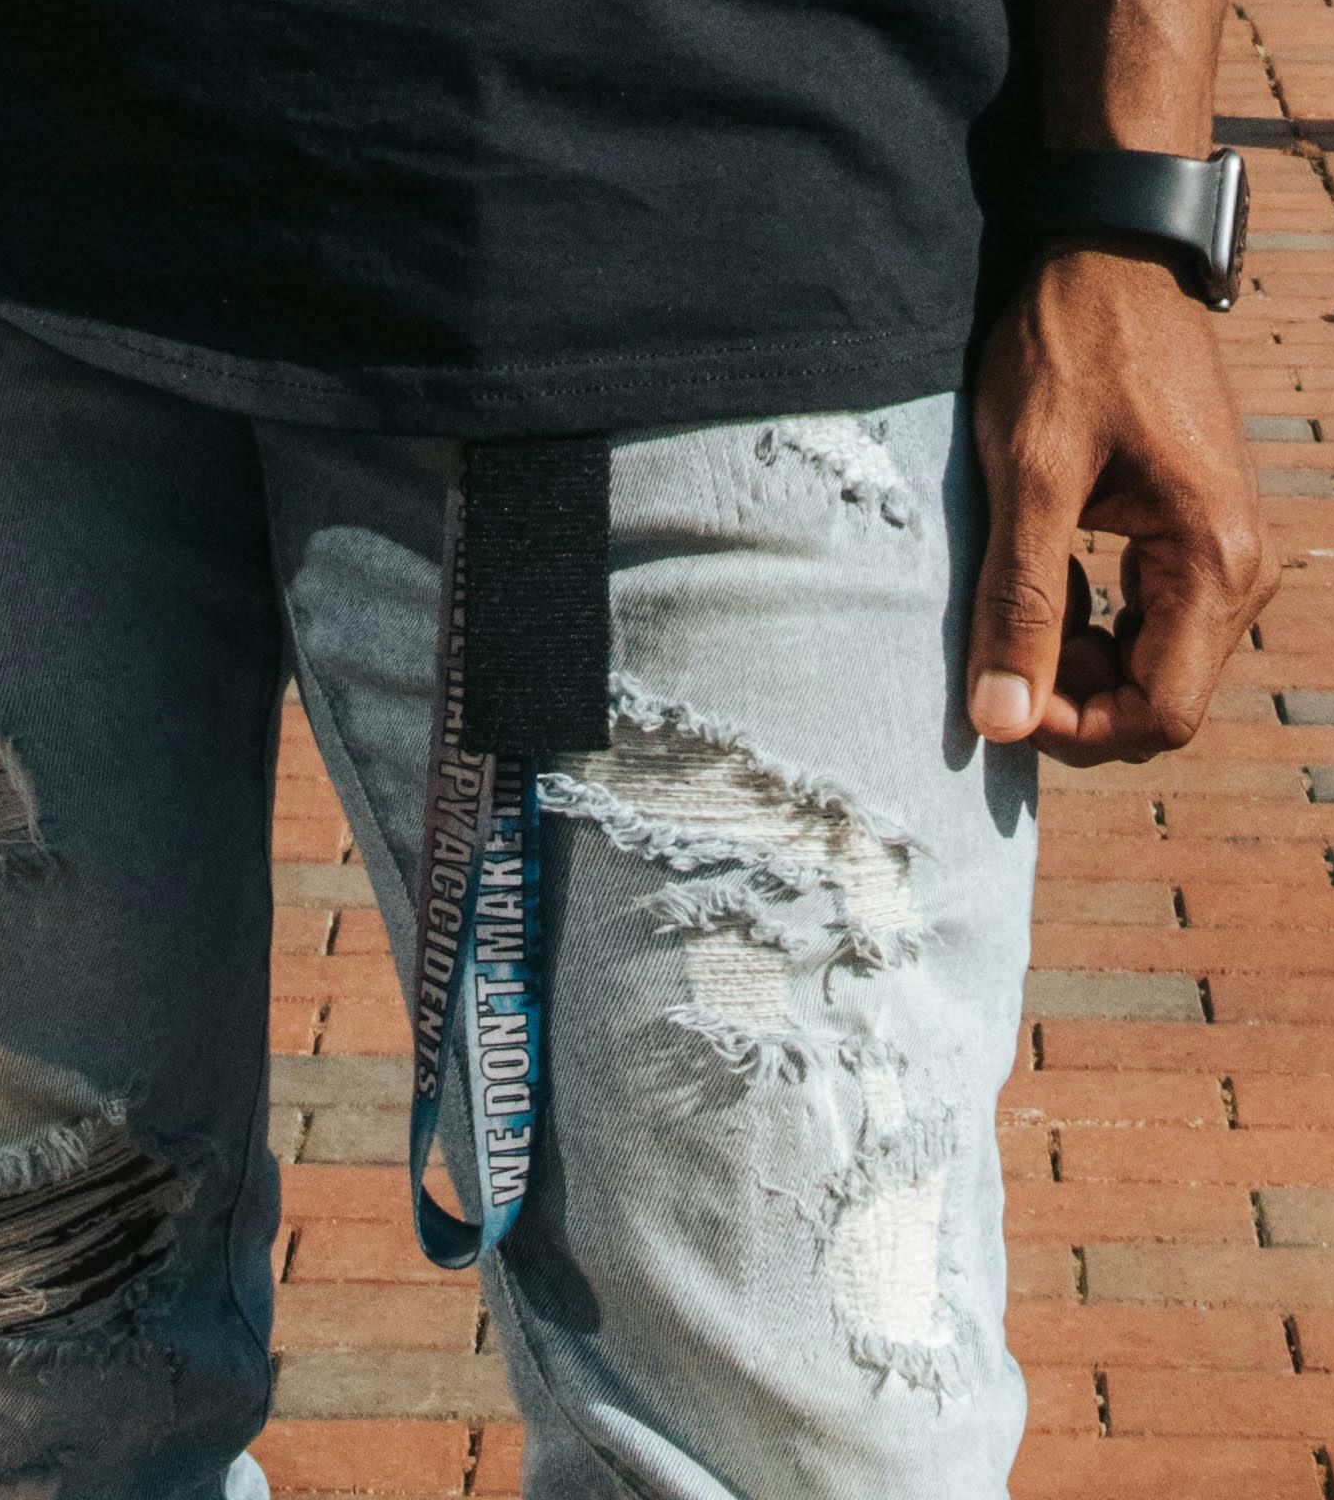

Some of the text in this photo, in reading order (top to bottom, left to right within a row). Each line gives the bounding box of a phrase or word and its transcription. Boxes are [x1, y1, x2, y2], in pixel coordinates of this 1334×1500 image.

[416, 828, 474, 1100] ACCIDENTS
[474, 832, 525, 962] MAKE
[475, 973, 531, 1117] DON'T
[486, 1124, 532, 1206] WE
